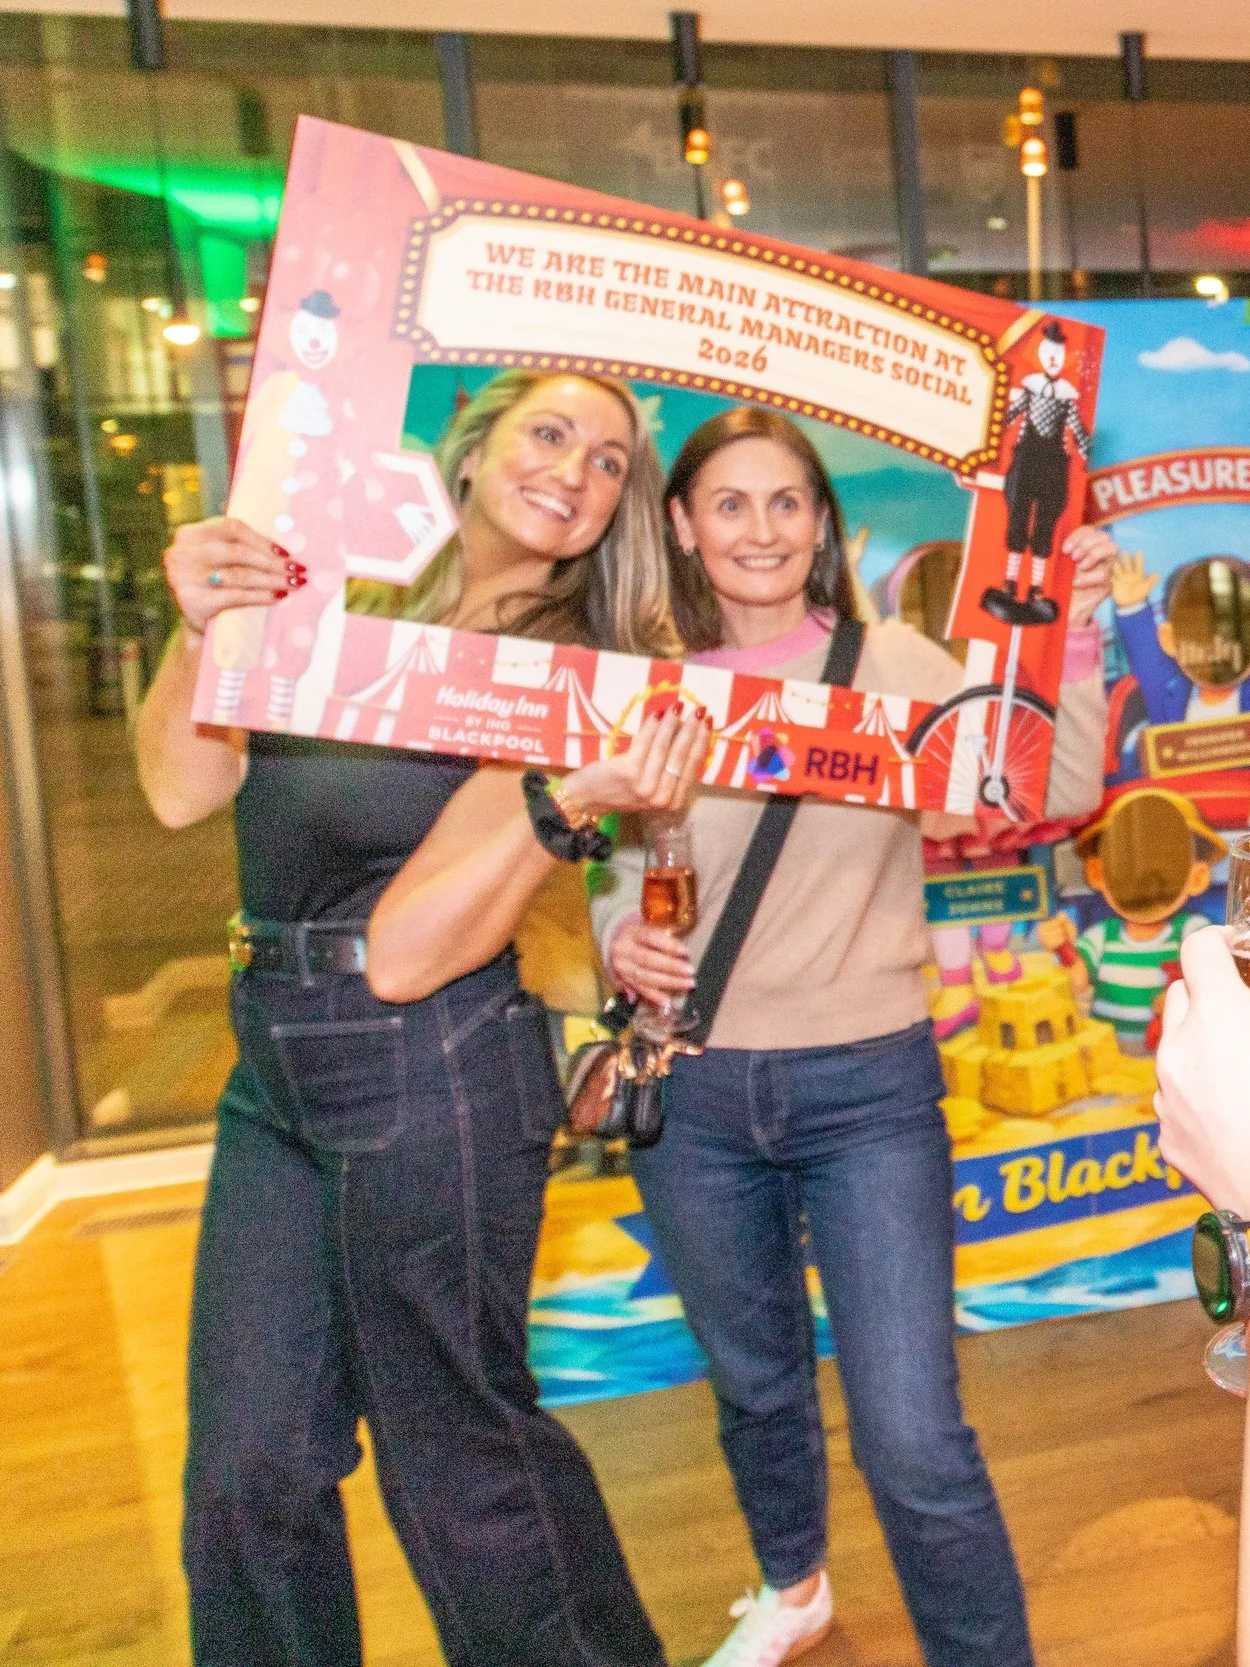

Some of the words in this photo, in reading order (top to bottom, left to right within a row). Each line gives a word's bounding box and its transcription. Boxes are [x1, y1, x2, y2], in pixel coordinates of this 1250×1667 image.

[485, 241, 535, 268] WE
[543, 249, 605, 278] ARE
[613, 259, 669, 289] THE
[676, 271, 757, 308] MAIN
[763, 291, 929, 362] ATTRACTION
[934, 348, 967, 377] AT
[466, 269, 524, 296] THE
[532, 278, 596, 306] RBH
[603, 289, 732, 332] GENERAL
[738, 316, 885, 375] MANAGERS
[891, 361, 973, 406] SOCIAL
[697, 337, 769, 373] 2026
[435, 684, 516, 716] Holiday
[515, 695, 549, 719] Inn
[427, 726, 544, 754] BLACKPOOL
[465, 716, 483, 728] BY
[804, 747, 879, 786] RBH
